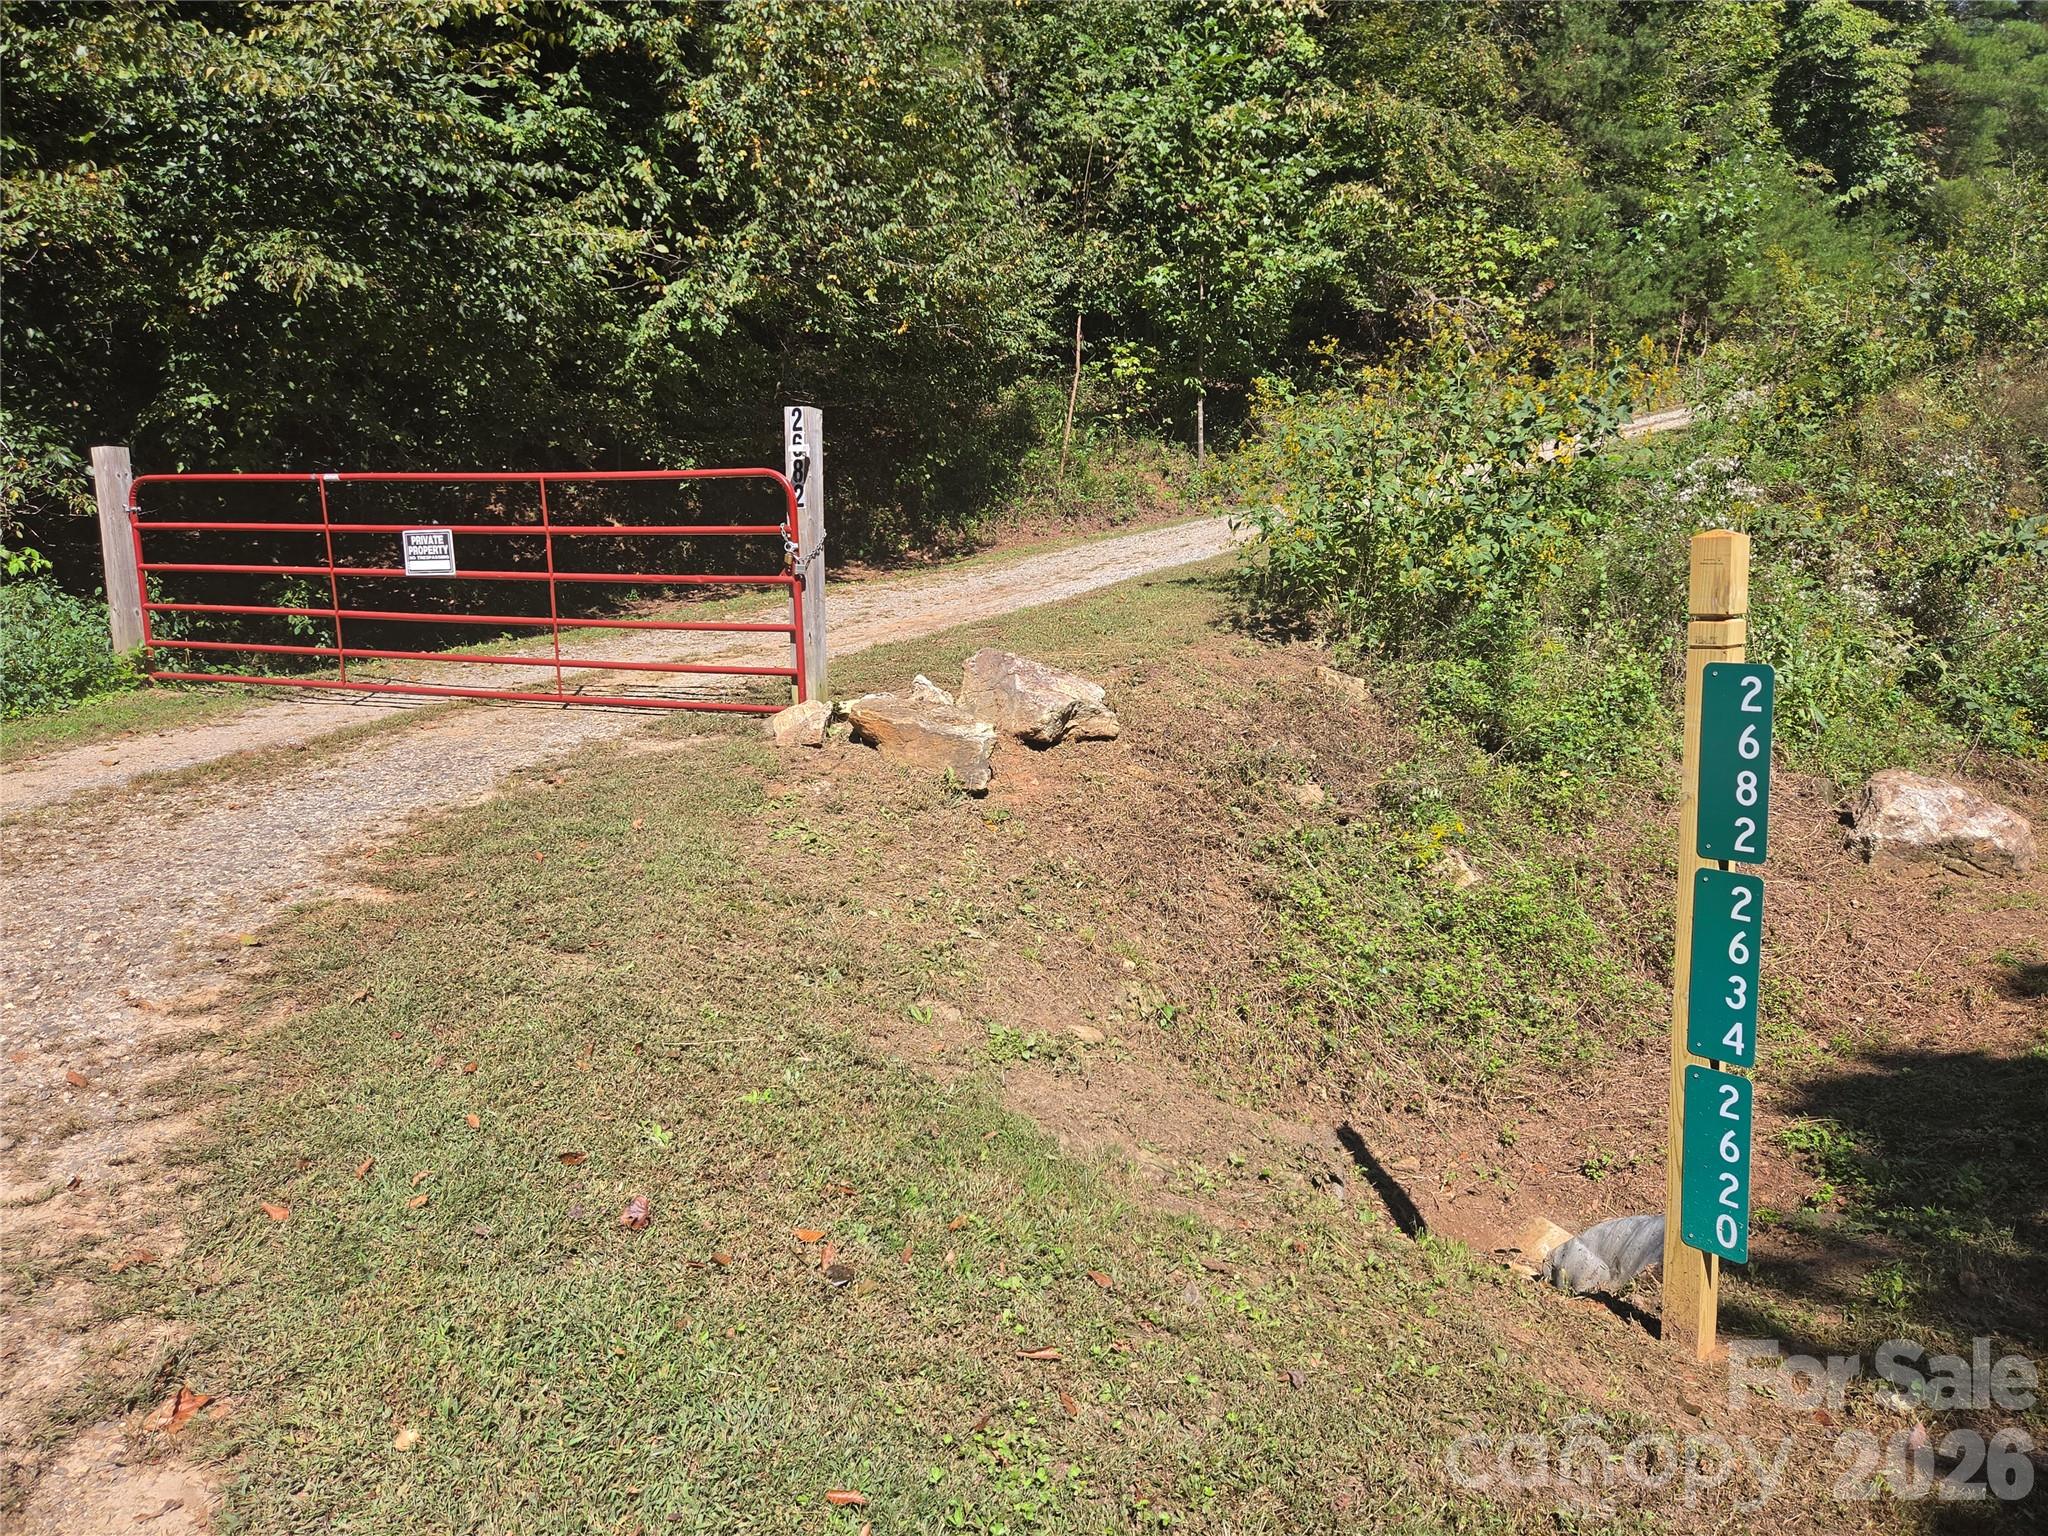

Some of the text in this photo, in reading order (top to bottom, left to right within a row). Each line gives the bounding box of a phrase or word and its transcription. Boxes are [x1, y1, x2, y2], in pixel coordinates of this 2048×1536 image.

[408, 544, 449, 555] PROPERTY
[410, 535, 444, 546] PRIVATE
[1734, 675, 1763, 854] 2682
[1722, 886, 1753, 1056] 2634
[1716, 1084, 1740, 1249] 2620
